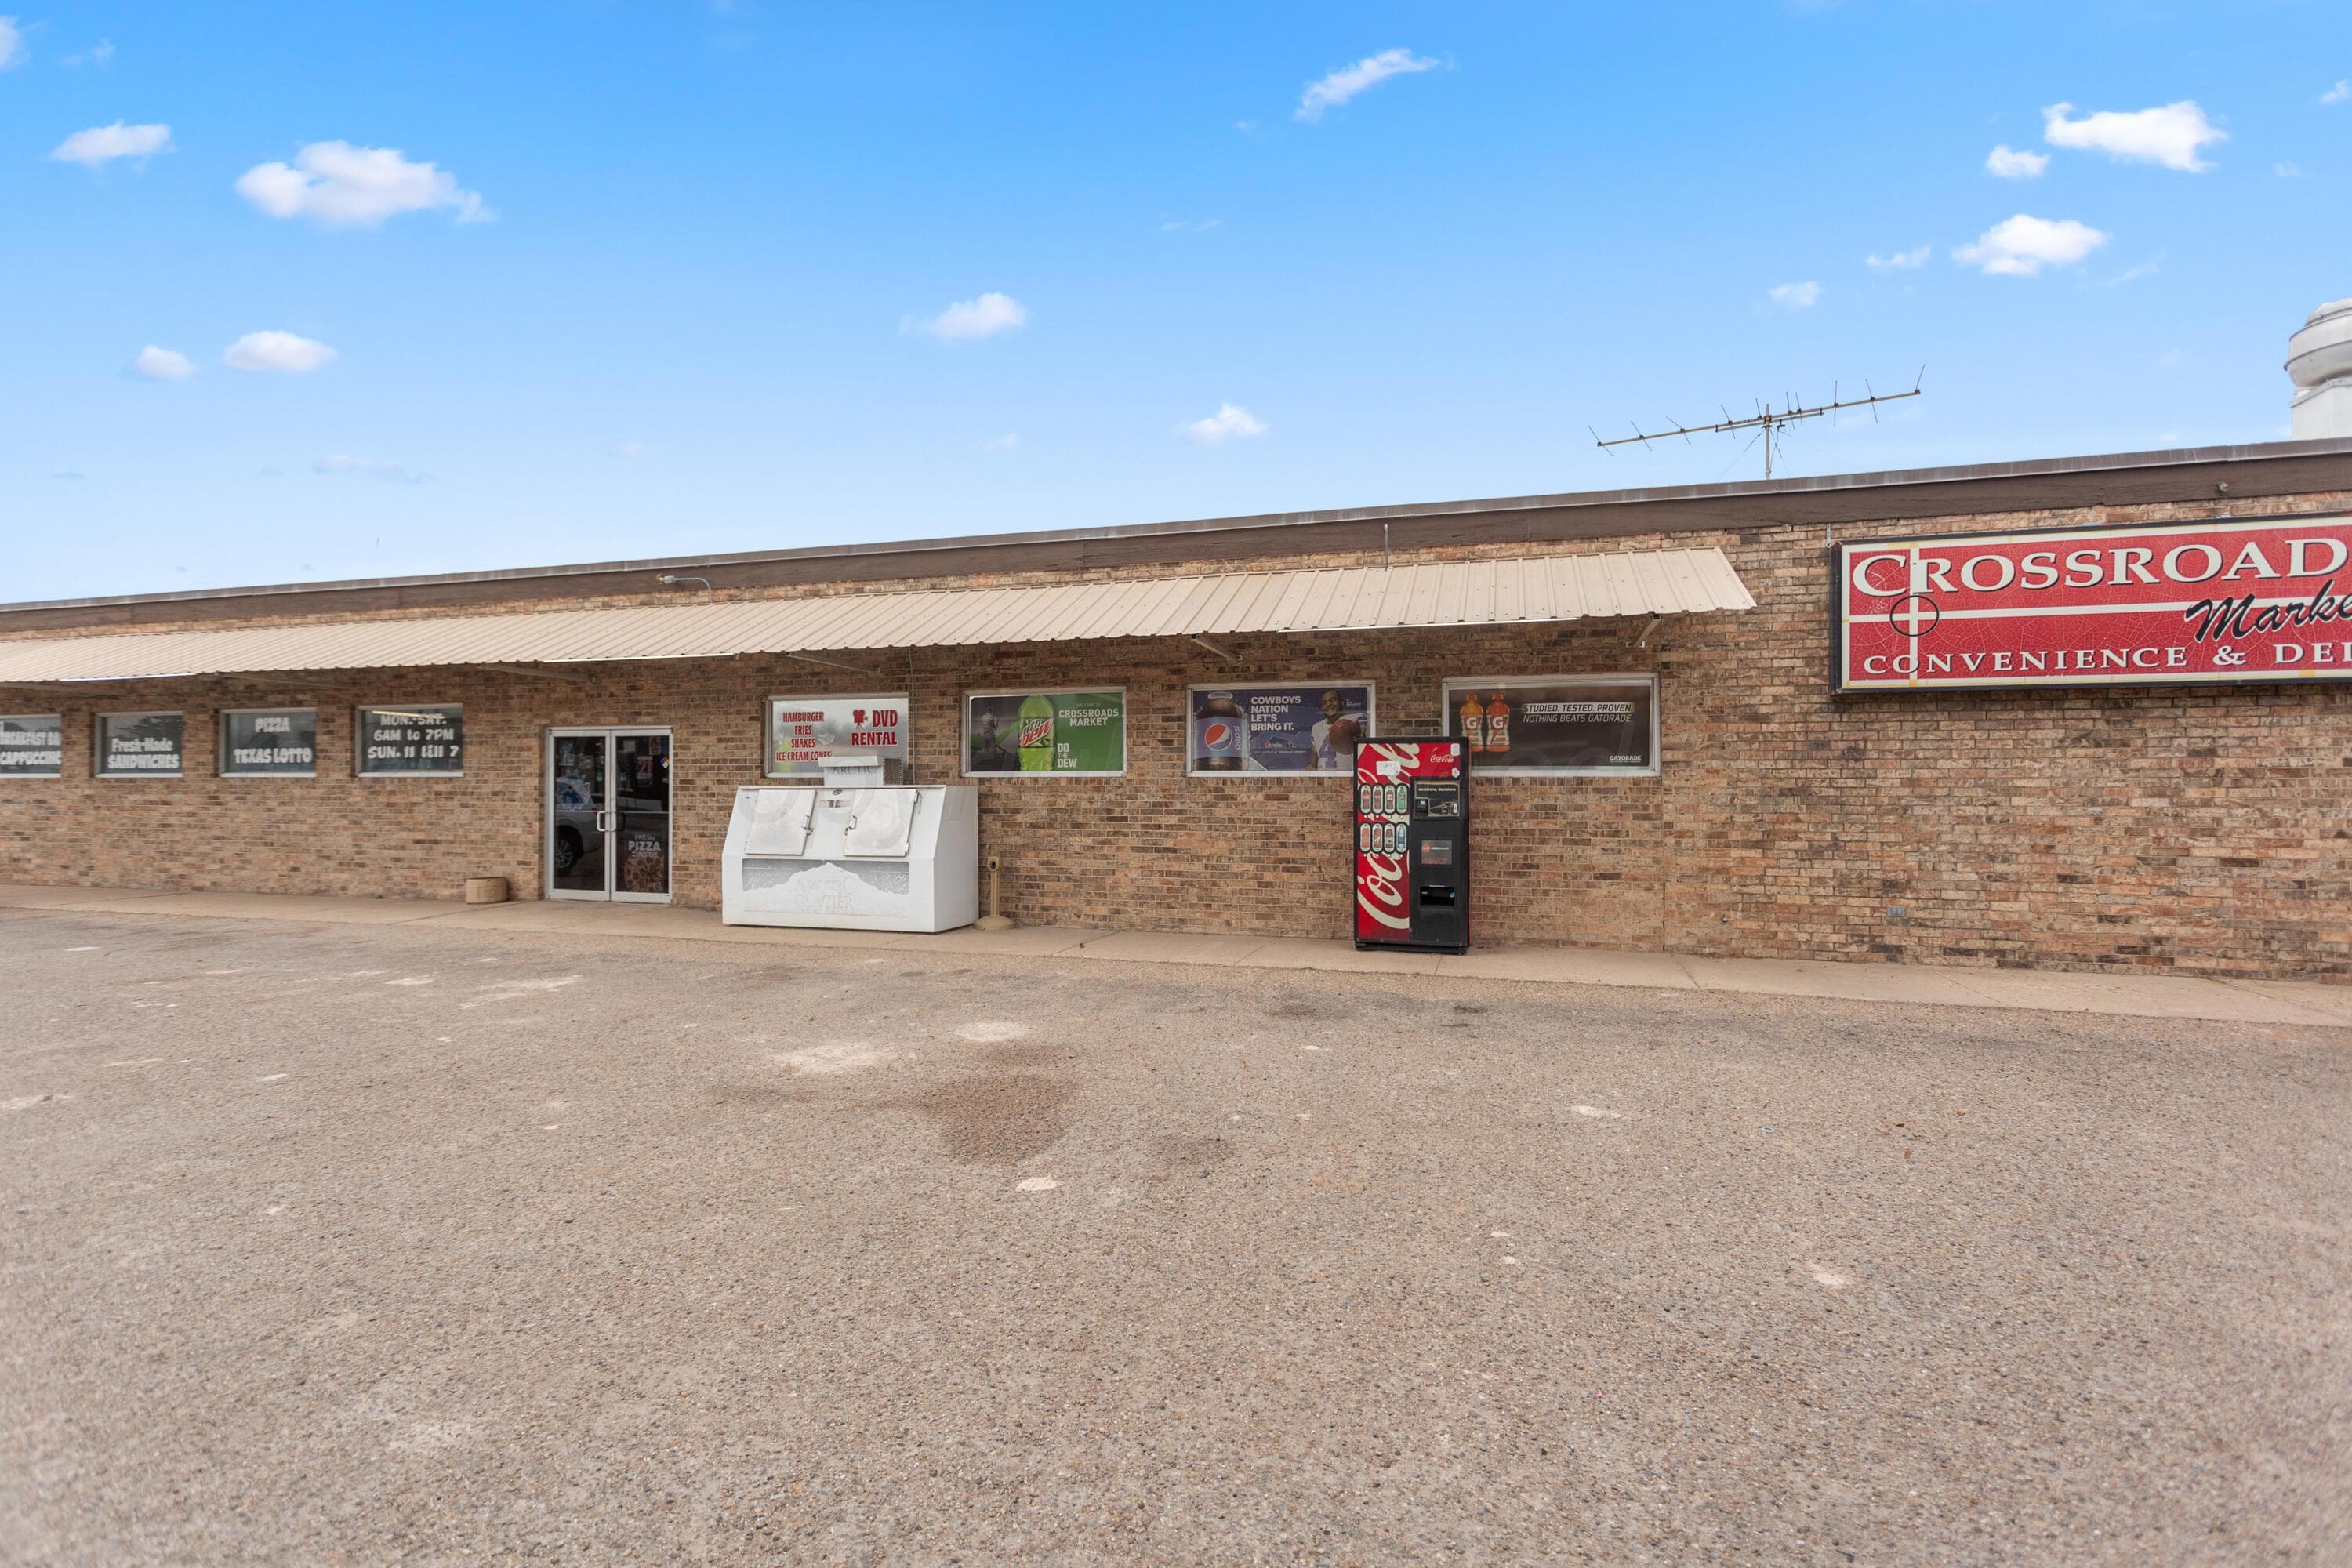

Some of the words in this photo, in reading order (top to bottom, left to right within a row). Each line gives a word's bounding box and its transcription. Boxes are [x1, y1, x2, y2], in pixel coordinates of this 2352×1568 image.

[1864, 647, 2188, 674] CONVENIENCE
[2212, 645, 2247, 665] &
[1250, 695, 1301, 705] COWBOYS
[1250, 705, 1289, 713] NATION
[1562, 703, 1595, 712] TESTED.
[1597, 703, 1632, 712] PROVEN.
[782, 711, 824, 723] HAMBURGER
[1058, 709, 1119, 718] CROSSROADS
[1250, 713, 1277, 722] LET'S
[1523, 714, 1558, 723] NOTHING
[1559, 713, 1586, 723] BEATS
[873, 710, 898, 728] DVD
[1069, 717, 1108, 727] MARKET
[1466, 717, 1477, 728] G
[1493, 716, 1504, 728] G
[255, 717, 290, 733] PIZZA
[794, 725, 812, 735] FRIES
[1250, 722, 1282, 731] BRING
[1283, 722, 1294, 731] IT.
[373, 729, 401, 741] 6AM
[407, 728, 421, 740] to
[426, 728, 454, 741] 7PM
[851, 732, 898, 746] RENTAL
[791, 738, 815, 748] SHAKES
[1058, 743, 1069, 752] DO
[234, 748, 272, 764] TEXAS
[273, 747, 313, 763] LOTTO
[367, 746, 401, 759] SUN.
[449, 745, 459, 757] 7
[776, 752, 786, 761] ICE
[787, 751, 808, 761] CREAM
[107, 754, 180, 768] SANDWICHES
[1058, 758, 1077, 768] DEW
[628, 840, 662, 851] PIZZA
